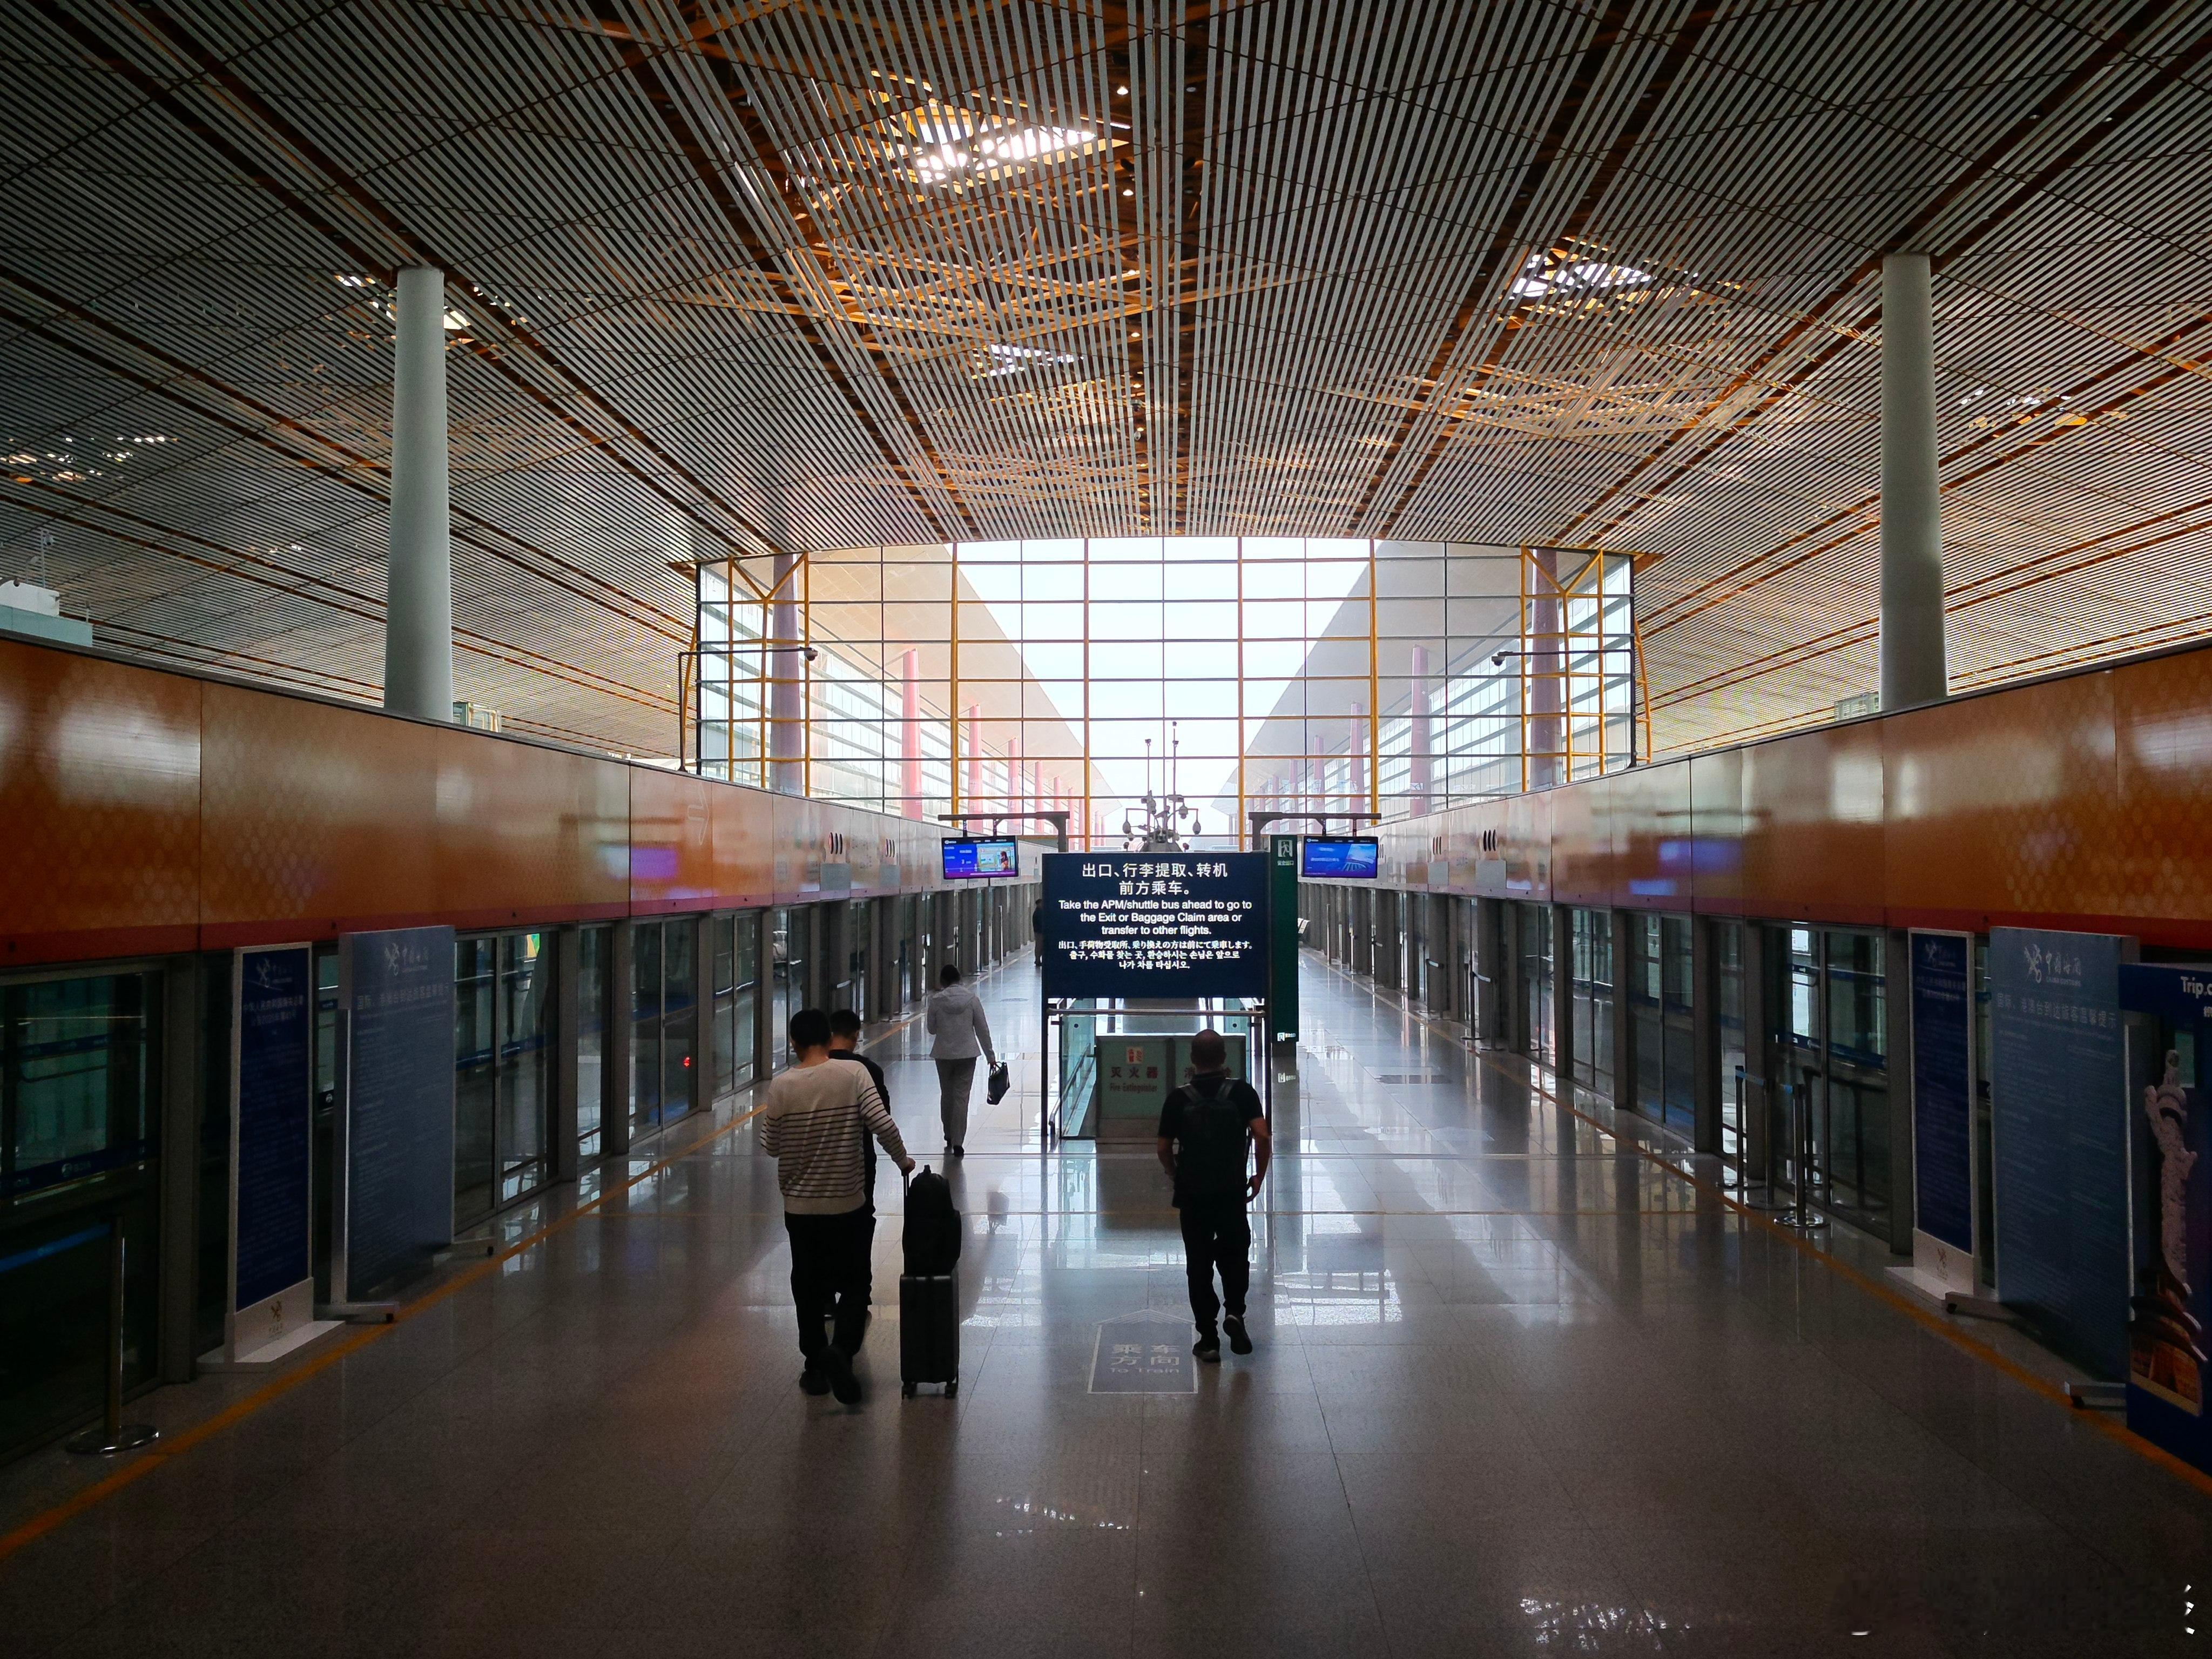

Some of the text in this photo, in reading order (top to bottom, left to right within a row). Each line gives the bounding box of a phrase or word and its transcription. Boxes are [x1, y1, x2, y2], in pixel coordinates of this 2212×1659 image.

[1082, 862, 1228, 878] 出口、行李提取、转机
[1119, 880, 1189, 895] 前方乘车。
[1058, 900, 1252, 912] Take the APM/shuttle bus ahead to go to
[1080, 913, 1096, 922] the
[1098, 913, 1117, 922] Exit
[1131, 913, 1176, 924] Baggage
[1177, 913, 1205, 922] Claim
[1102, 925, 1212, 937] transfer to other flights.
[1069, 950, 1240, 960] 출구, 수화물 찾는 곳, 환승하시는 손님은 앞으로
[1119, 960, 1190, 970] 나가 차를 타십시오.
[1111, 1067, 1158, 1078] 灭火器
[1110, 1355, 1179, 1365] 方向
